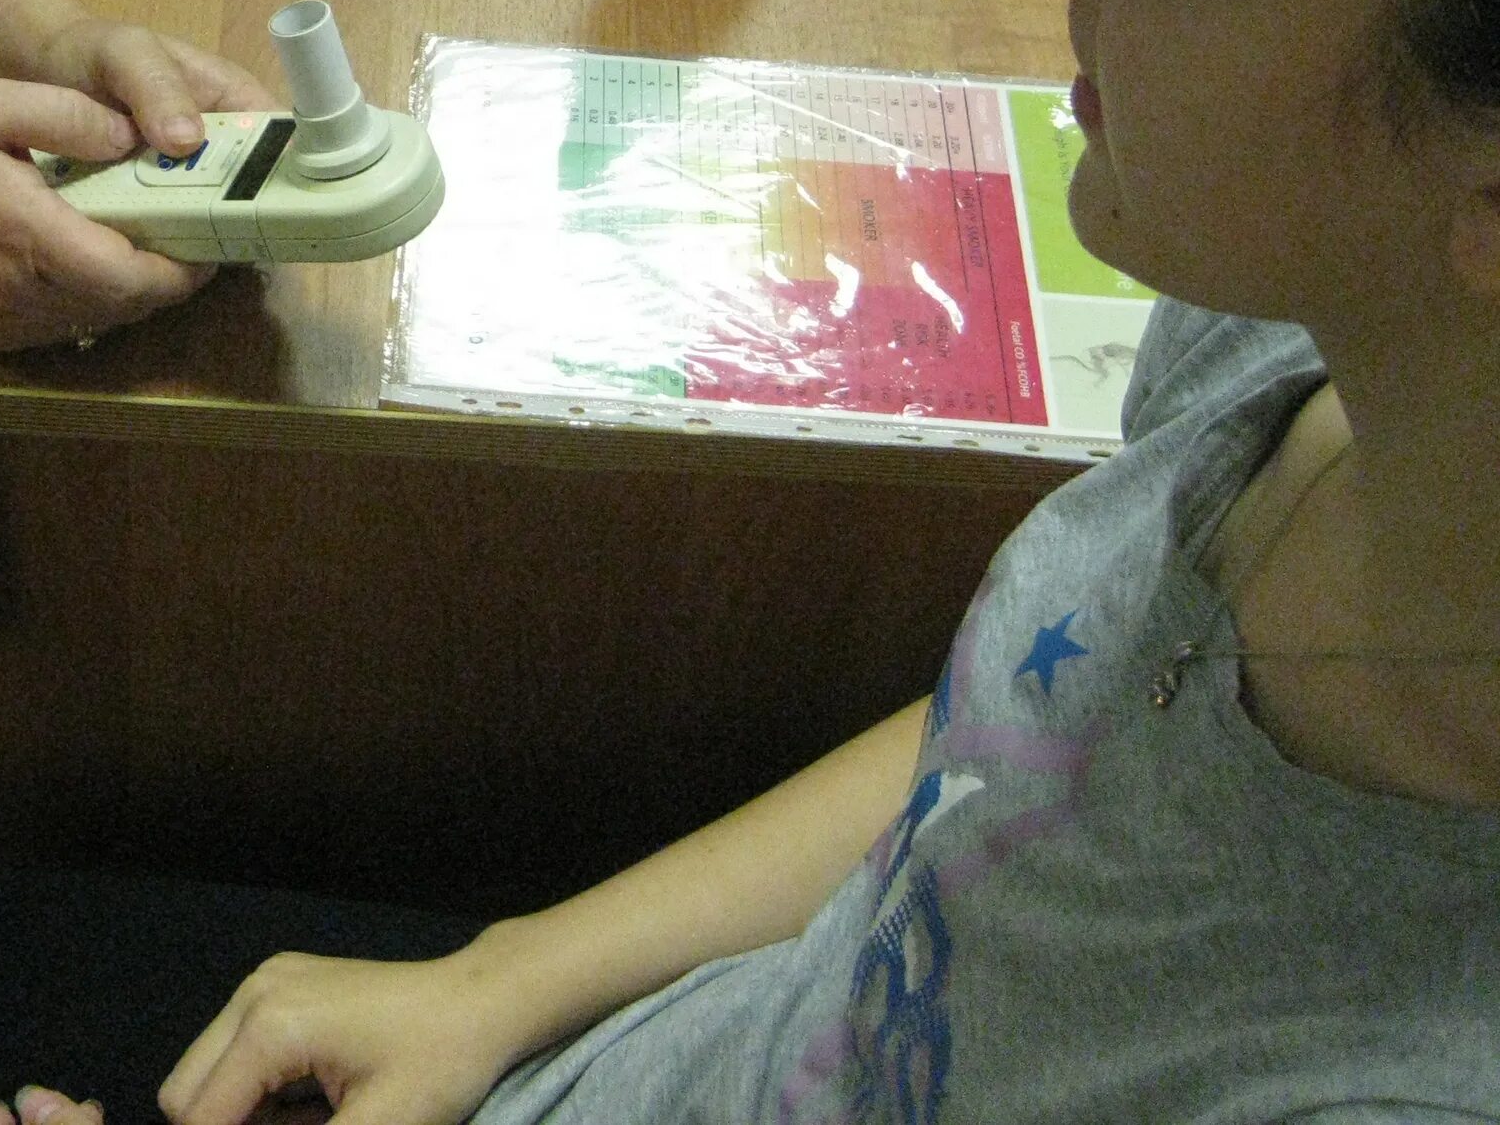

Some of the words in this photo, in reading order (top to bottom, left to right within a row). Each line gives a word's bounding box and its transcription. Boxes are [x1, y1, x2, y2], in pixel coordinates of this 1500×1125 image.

[589, 109, 598, 124] 0.32
[861, 199, 877, 242] SMOKER
[966, 225, 984, 268] SMOKER
[1010, 321, 1024, 346] Foetal
[1014, 346, 1025, 360] CO
